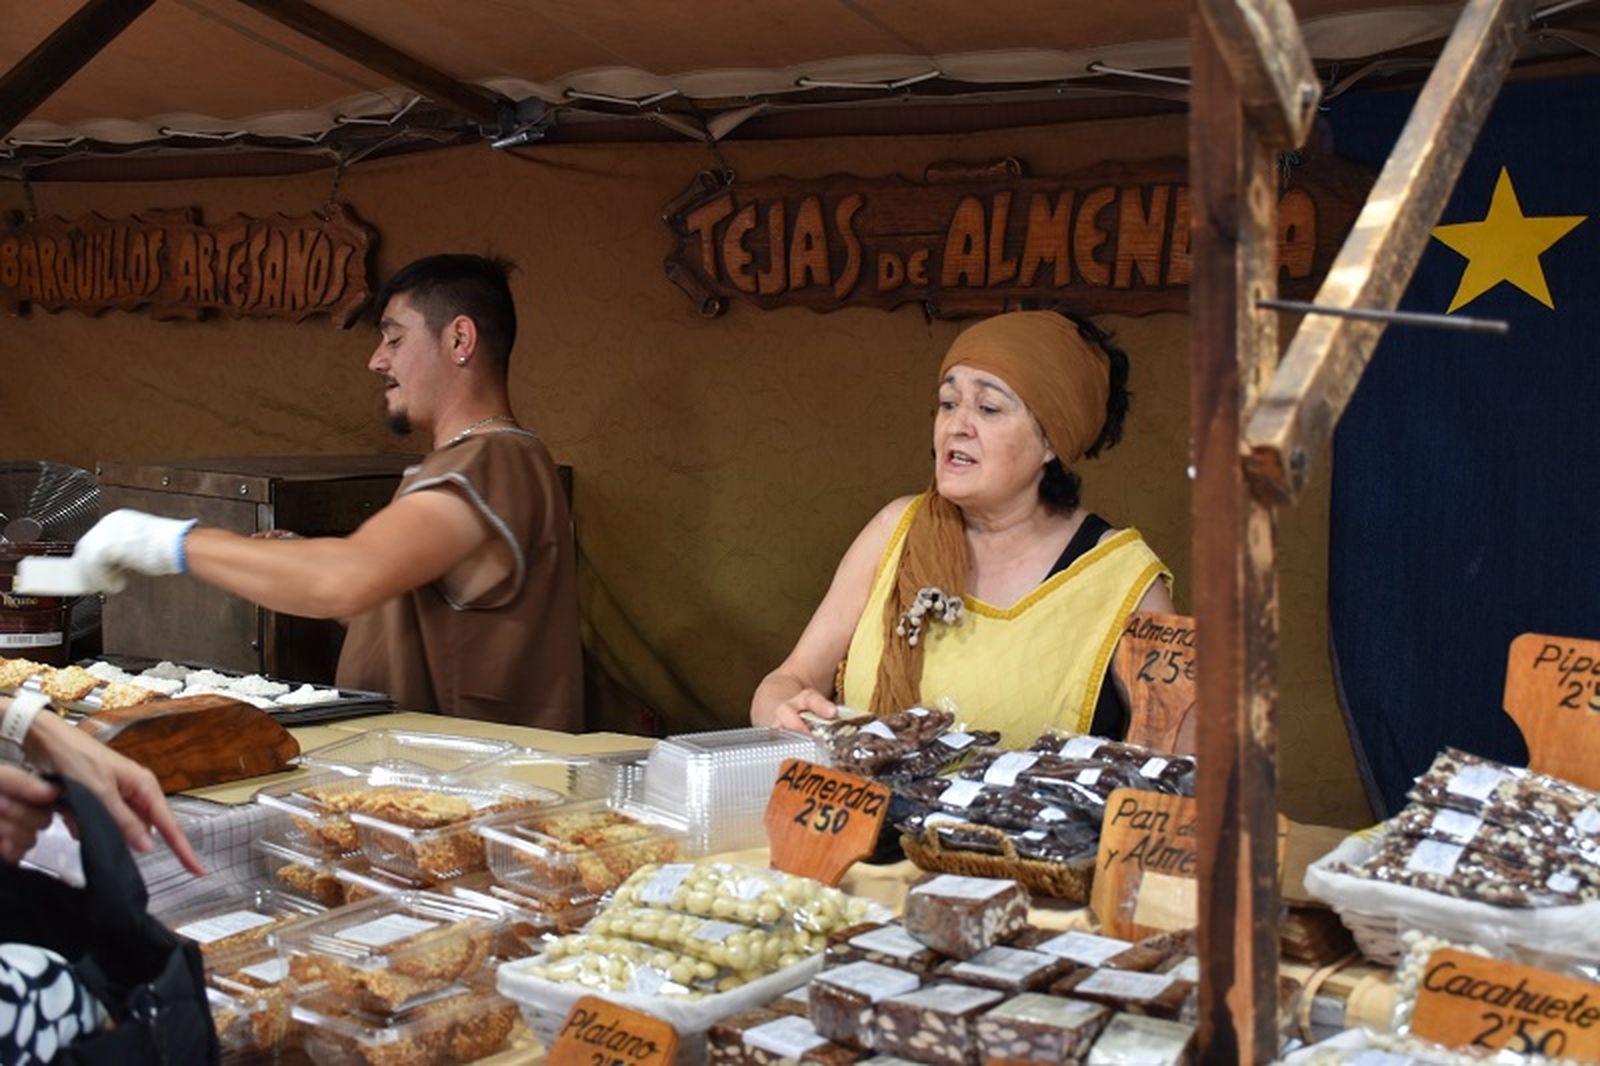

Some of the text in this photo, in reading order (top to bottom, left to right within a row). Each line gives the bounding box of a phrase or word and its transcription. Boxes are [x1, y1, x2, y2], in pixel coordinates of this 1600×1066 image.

[0, 224, 356, 308] BARQUILLOS ARTESANOS
[687, 187, 1316, 297] TEJAS DE ALMENA
[776, 761, 886, 816] Almendra
[794, 797, 849, 834] 2'50
[1111, 797, 1170, 832] Pan
[1424, 961, 1600, 1029] Cacahuete
[560, 1007, 661, 1059] Platano
